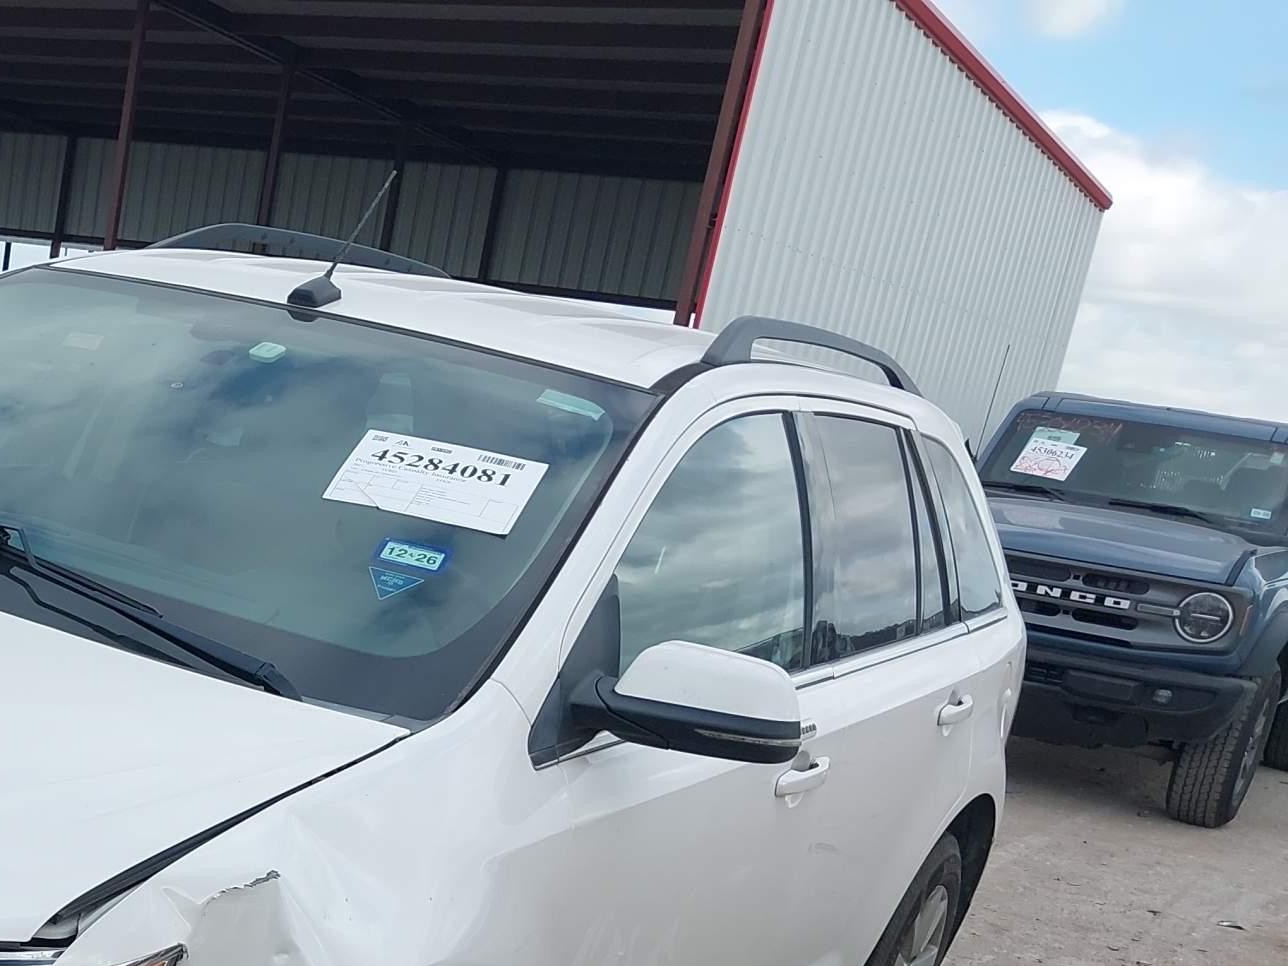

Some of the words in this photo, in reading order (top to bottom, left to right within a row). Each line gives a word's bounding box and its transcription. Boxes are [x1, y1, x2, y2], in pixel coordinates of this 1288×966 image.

[371, 448, 512, 487] 45284081
[388, 547, 408, 558] 12
[415, 553, 438, 565] 26
